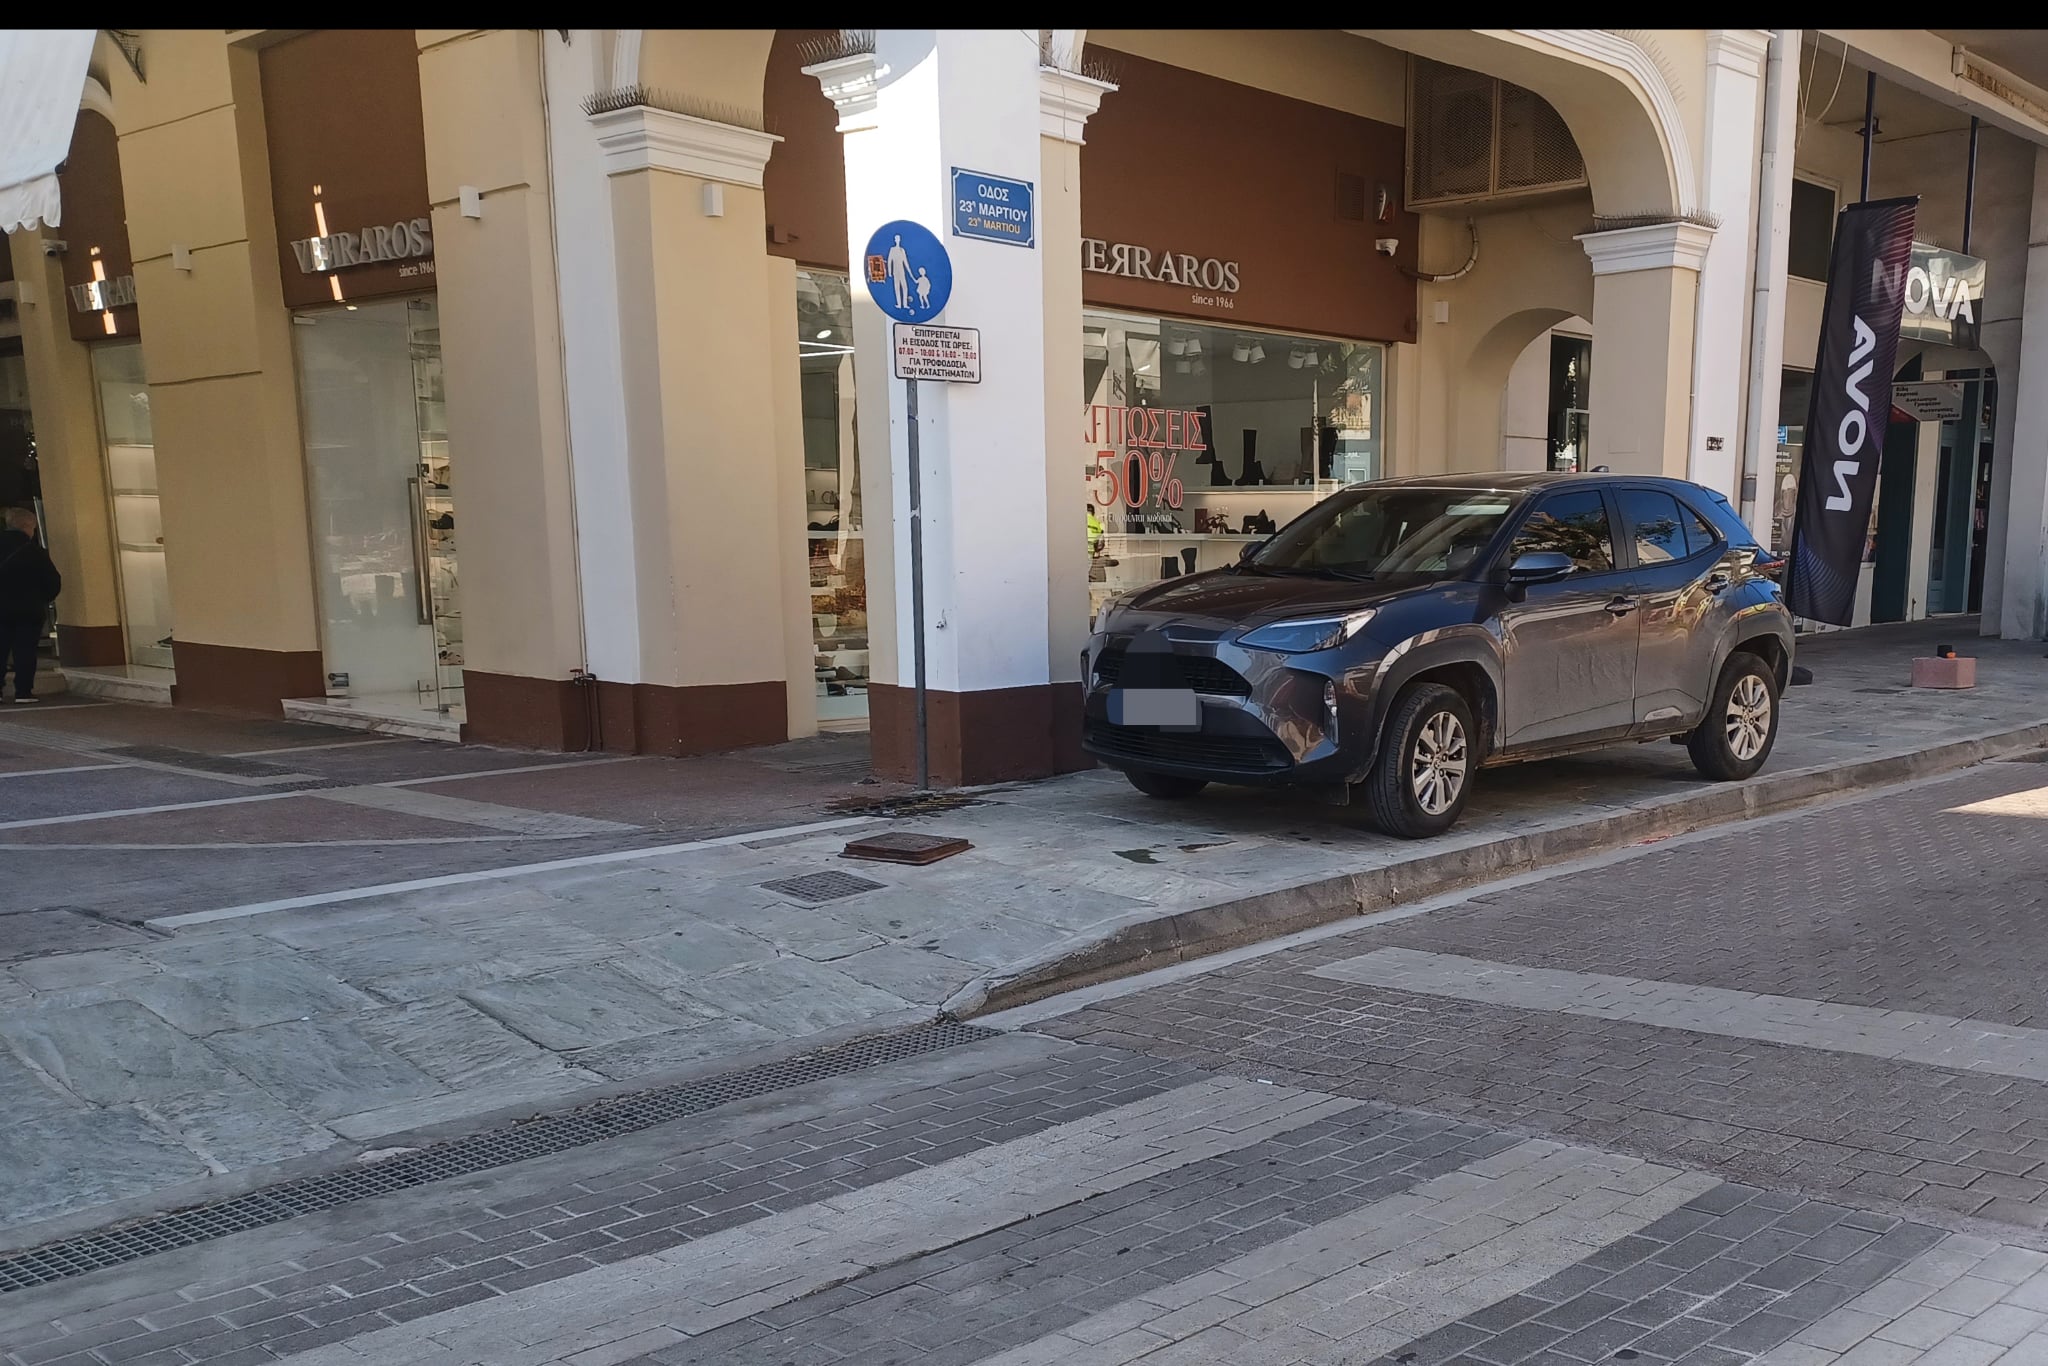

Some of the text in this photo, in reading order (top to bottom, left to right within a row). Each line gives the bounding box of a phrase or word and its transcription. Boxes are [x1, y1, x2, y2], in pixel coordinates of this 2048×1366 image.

[978, 184, 1009, 202] ΟΔΟΣ
[979, 202, 1028, 222] ΜΑΡΤΙΟΥ
[983, 219, 1021, 234] MARTIOU
[399, 261, 435, 278] since 1966
[1191, 293, 1235, 309] since 1966
[914, 328, 961, 340] ΕΠΙΤΡΕΠΕΤΑΙ
[902, 337, 908, 346] Η
[910, 338, 939, 348] ΕΙΣΟΔΟΣ
[941, 340, 952, 349] ΤΙΣ
[909, 357, 967, 369] ΓΙΑ ΤΡΟΦΟΔΟΣΙΑ
[902, 366, 975, 379] ΤΩΝ ΚΑΤΑΣΤΗΜΑΤΩΝ
[1824, 314, 1877, 512] NOVA
[1084, 404, 1207, 451] ΠΤΩΣΕΙΣ
